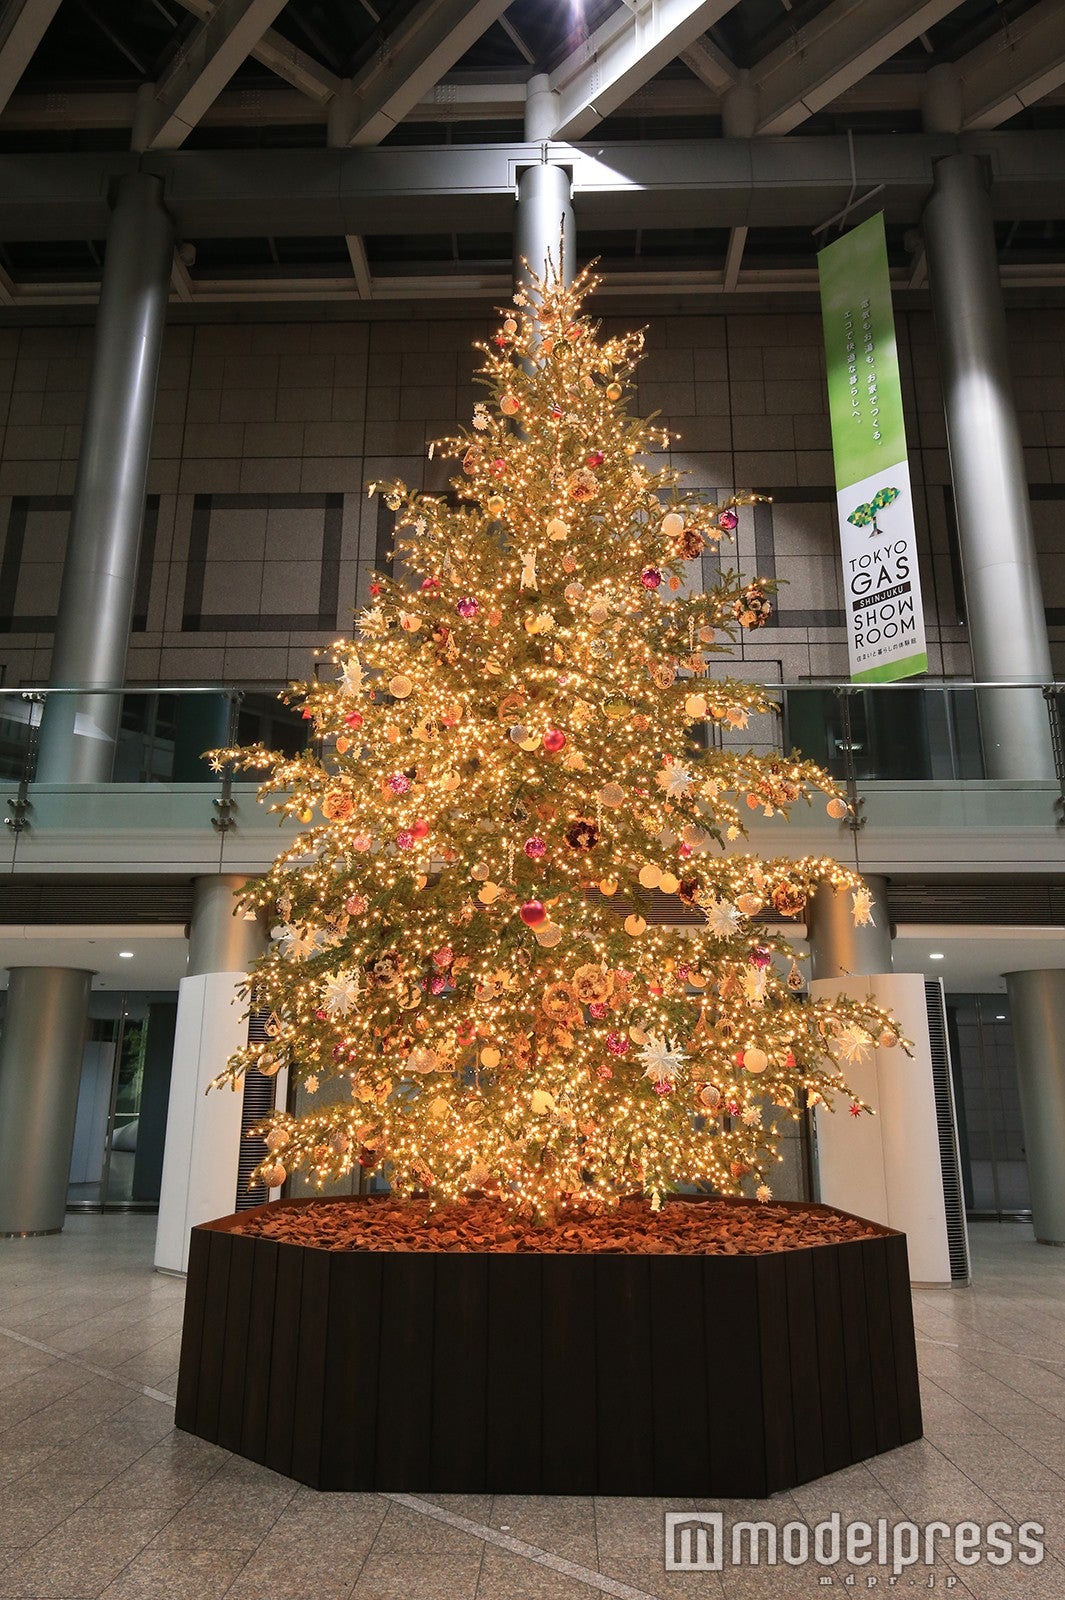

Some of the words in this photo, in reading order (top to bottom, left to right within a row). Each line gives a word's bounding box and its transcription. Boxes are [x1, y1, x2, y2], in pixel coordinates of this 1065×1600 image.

[849, 540, 907, 572] TOKYO
[851, 556, 910, 595] GAS
[854, 596, 914, 631] SHOW
[859, 585, 904, 608] SHINJUKU
[855, 615, 915, 649] ROOM
